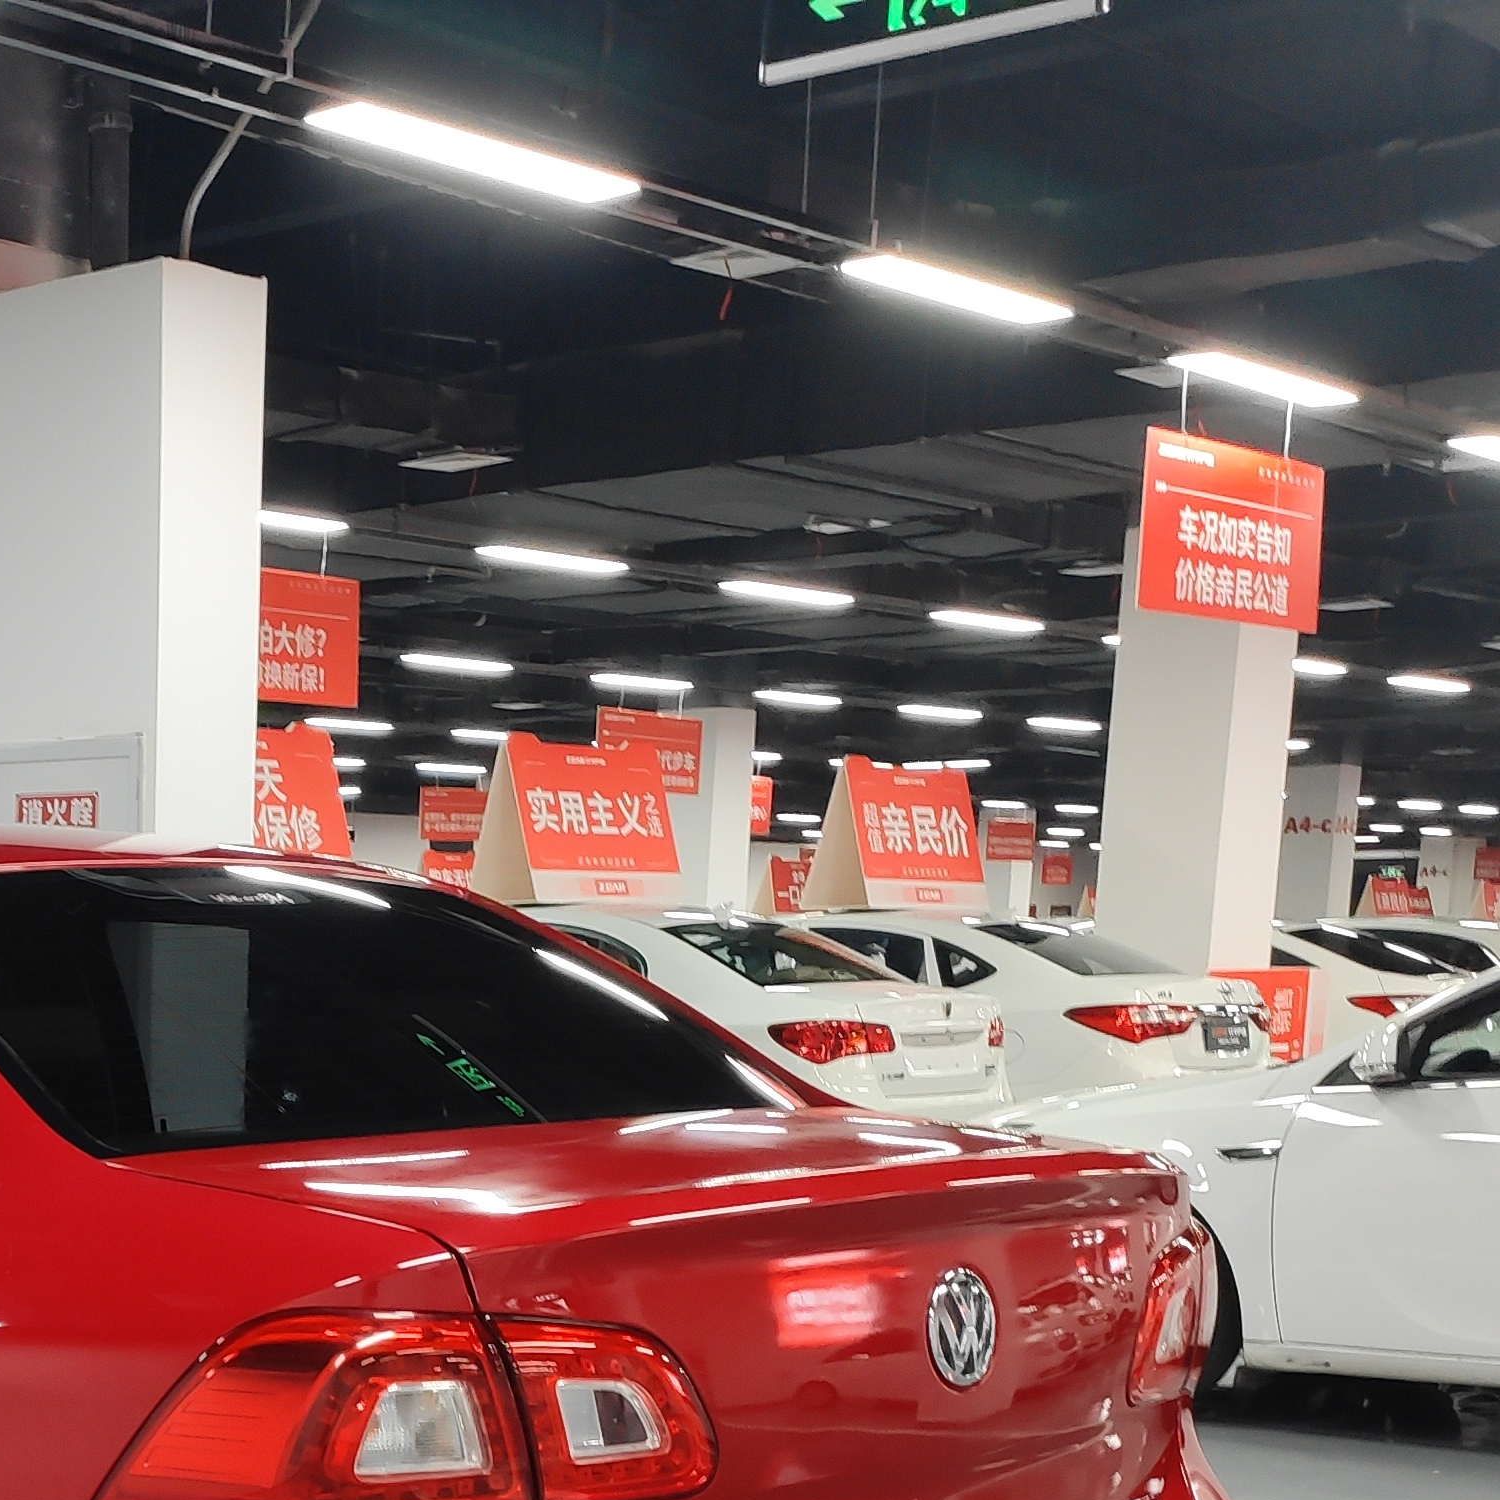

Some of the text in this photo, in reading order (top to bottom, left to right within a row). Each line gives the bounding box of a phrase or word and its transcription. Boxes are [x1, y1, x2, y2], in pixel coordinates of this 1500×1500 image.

[1177, 504, 1292, 566] 车况如实告知
[1175, 556, 1290, 617] 价格亲民公道
[255, 758, 288, 803] 天
[254, 803, 323, 851] 保修
[525, 786, 649, 837] 实用主义
[881, 801, 970, 858] 亲民价
